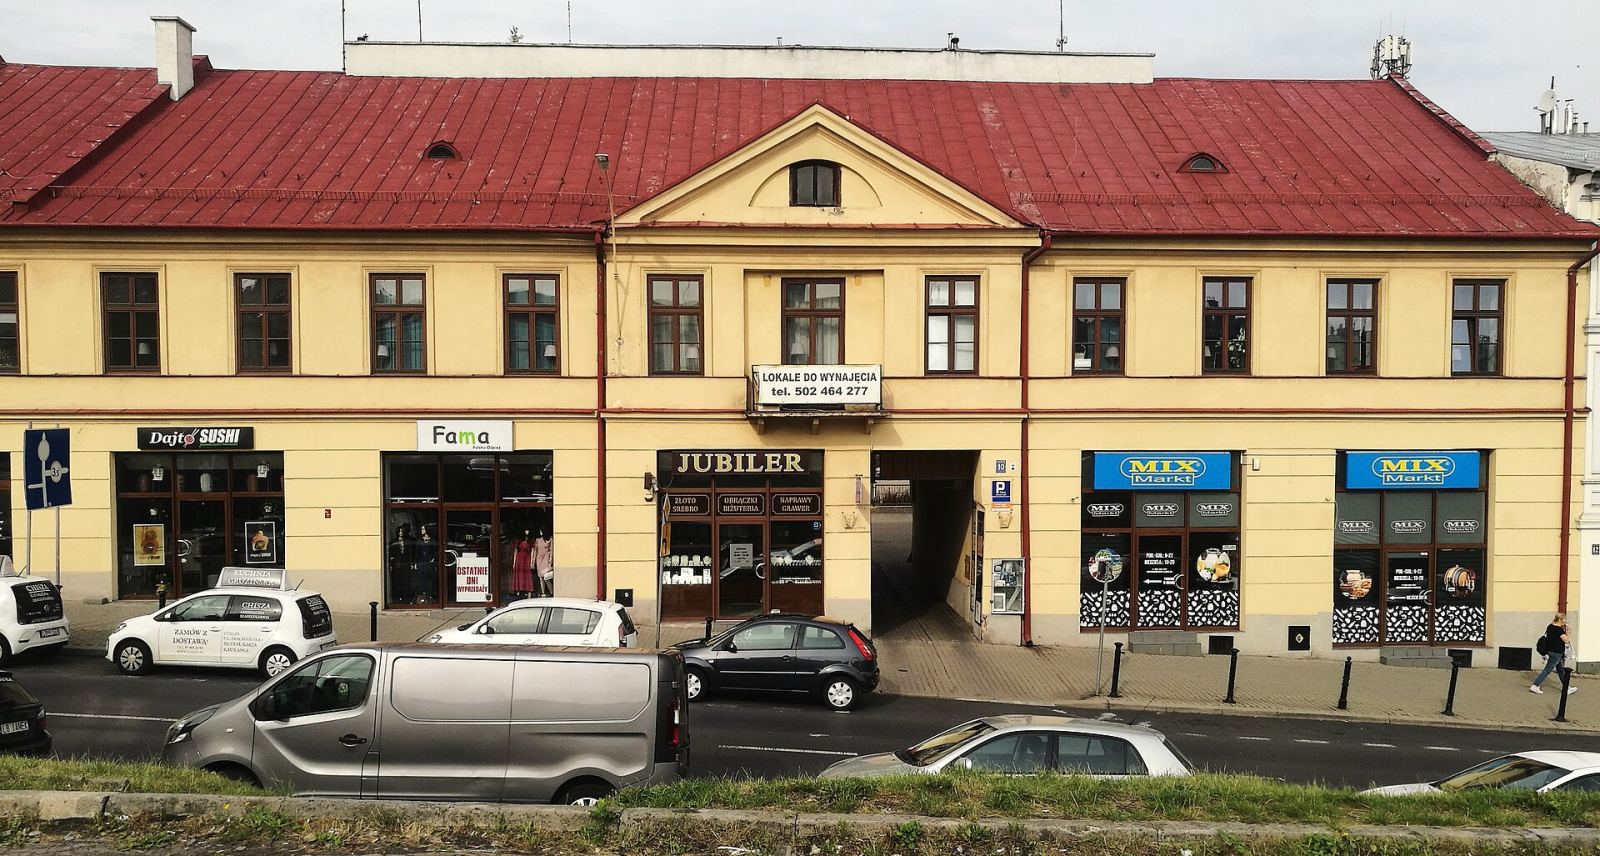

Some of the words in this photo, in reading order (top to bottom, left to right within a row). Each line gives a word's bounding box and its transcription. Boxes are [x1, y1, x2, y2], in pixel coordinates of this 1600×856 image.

[762, 373, 801, 382] LOKALE
[804, 373, 817, 382] DO
[820, 373, 877, 384] WYNAJĘCIA
[772, 388, 790, 396] tel.
[795, 387, 817, 396] 502
[821, 387, 842, 396] 464
[846, 387, 868, 396] 277
[199, 428, 240, 443] SUSHI
[433, 425, 490, 445] Fama
[677, 453, 805, 473] JUBILER
[997, 463, 1005, 471] 10
[1129, 460, 1198, 473] MIX
[1380, 459, 1448, 472] MIX
[1135, 475, 1192, 483] Markt
[1386, 474, 1441, 482] Markt
[674, 496, 697, 504] ZŁOTO
[724, 496, 758, 506] OBRĄCZKI
[780, 496, 812, 504] NAPRAWY
[723, 504, 759, 512] BIŻUTERIA
[234, 569, 272, 577] KUCHNIA
[457, 567, 488, 575] OSTATNIE
[467, 577, 478, 585] DNI
[457, 584, 488, 592] WYPRZEDAŻY
[174, 627, 201, 636] ZAMÓW
